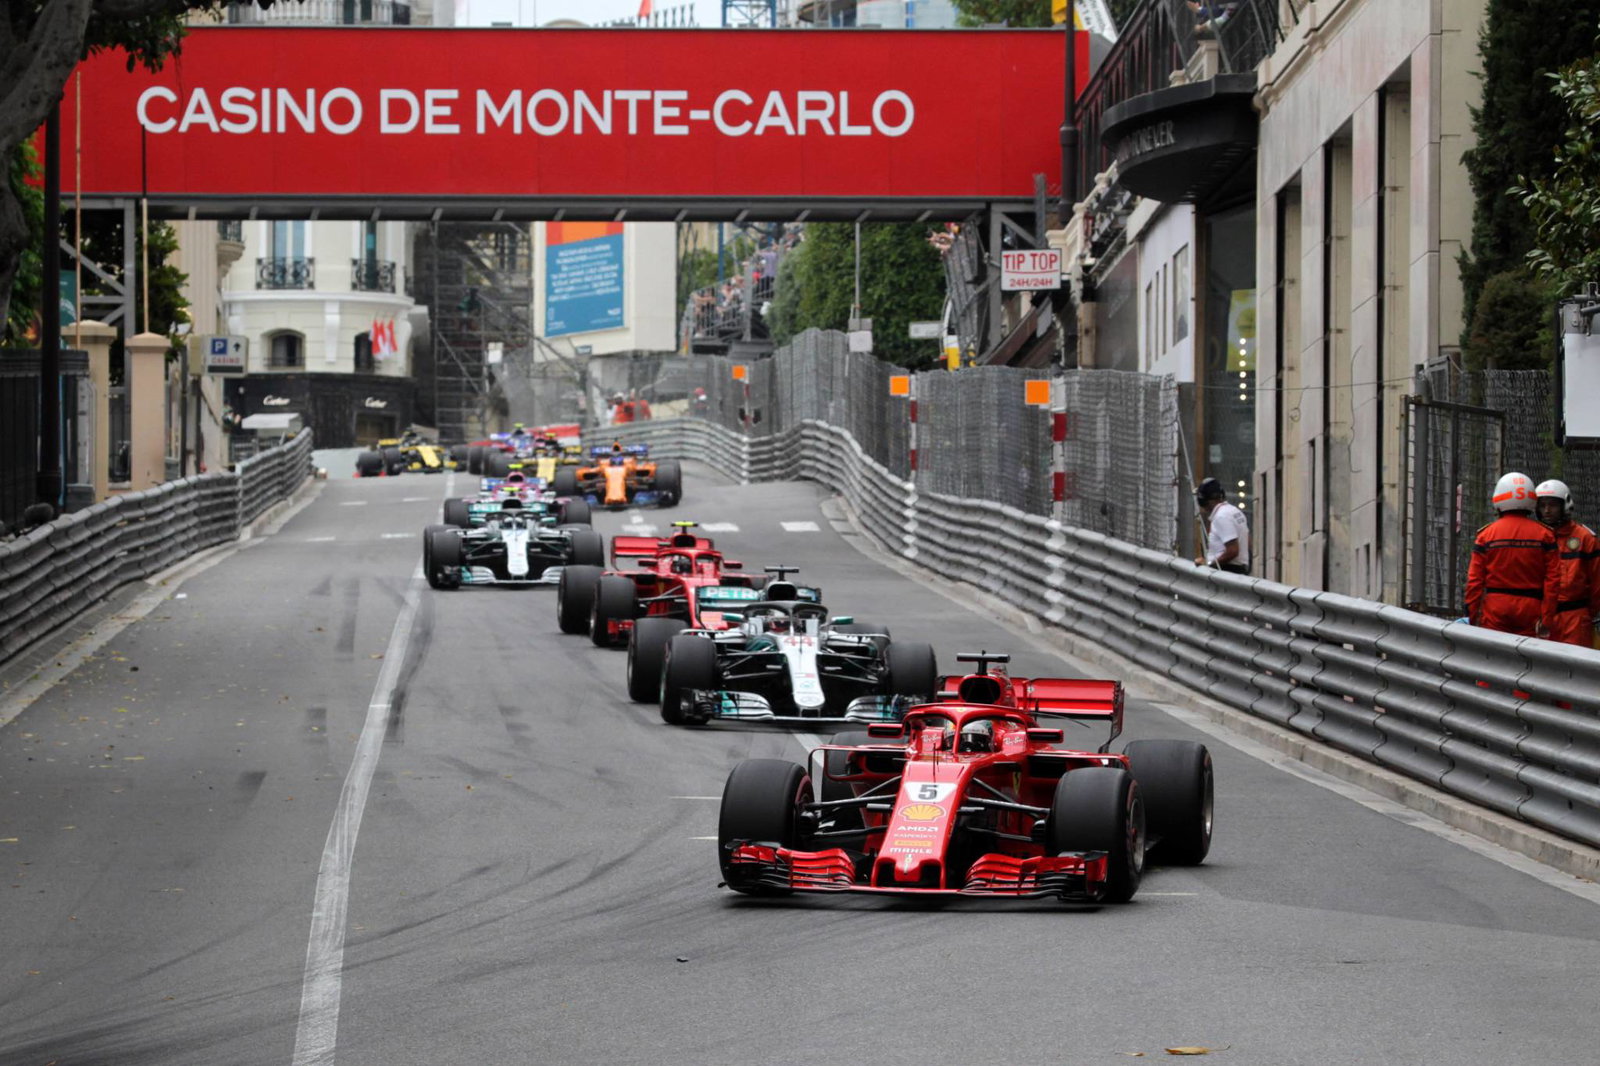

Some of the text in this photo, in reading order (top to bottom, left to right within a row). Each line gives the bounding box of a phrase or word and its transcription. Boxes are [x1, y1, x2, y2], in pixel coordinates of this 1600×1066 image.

[136, 86, 915, 137] CASINO DE MONTE-CARLO
[1003, 252, 1058, 270] TIP TOP
[1009, 278, 1053, 287] 24H/24H
[214, 341, 224, 352] P
[211, 356, 240, 364] CASINO
[1515, 487, 1526, 500] S
[784, 636, 816, 647] 44
[918, 784, 938, 800] 5
